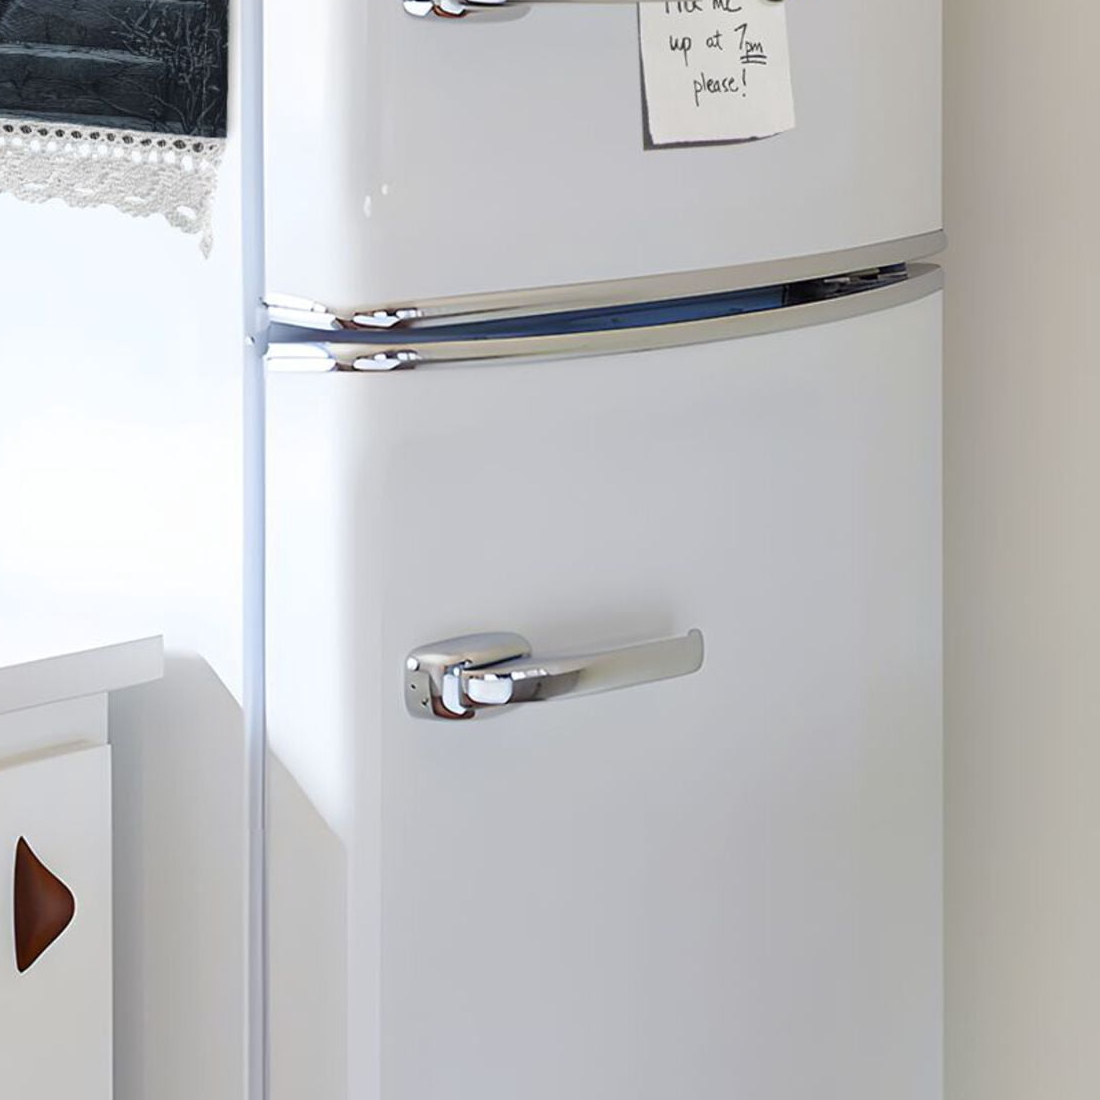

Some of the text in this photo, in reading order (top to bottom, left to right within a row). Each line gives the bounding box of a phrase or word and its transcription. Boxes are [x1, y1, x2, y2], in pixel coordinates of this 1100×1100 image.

[669, 35, 692, 67] up
[706, 29, 723, 51] at
[693, 68, 747, 107] please!
